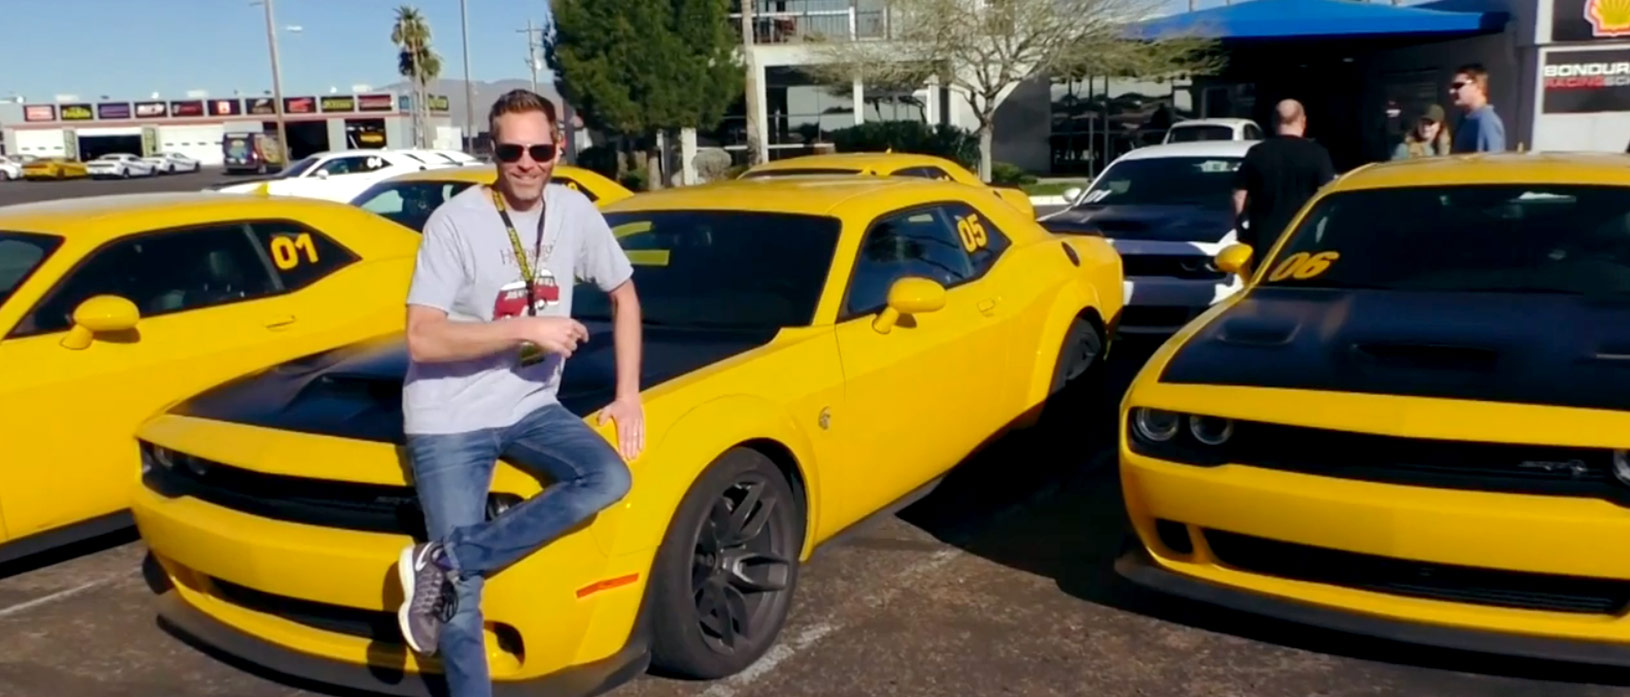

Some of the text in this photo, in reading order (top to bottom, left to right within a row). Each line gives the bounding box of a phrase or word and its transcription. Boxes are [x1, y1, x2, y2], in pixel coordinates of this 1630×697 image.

[1544, 62, 1630, 77] BONDUR
[957, 213, 987, 252] 05
[270, 232, 319, 271] 01
[1268, 251, 1340, 282] 06
